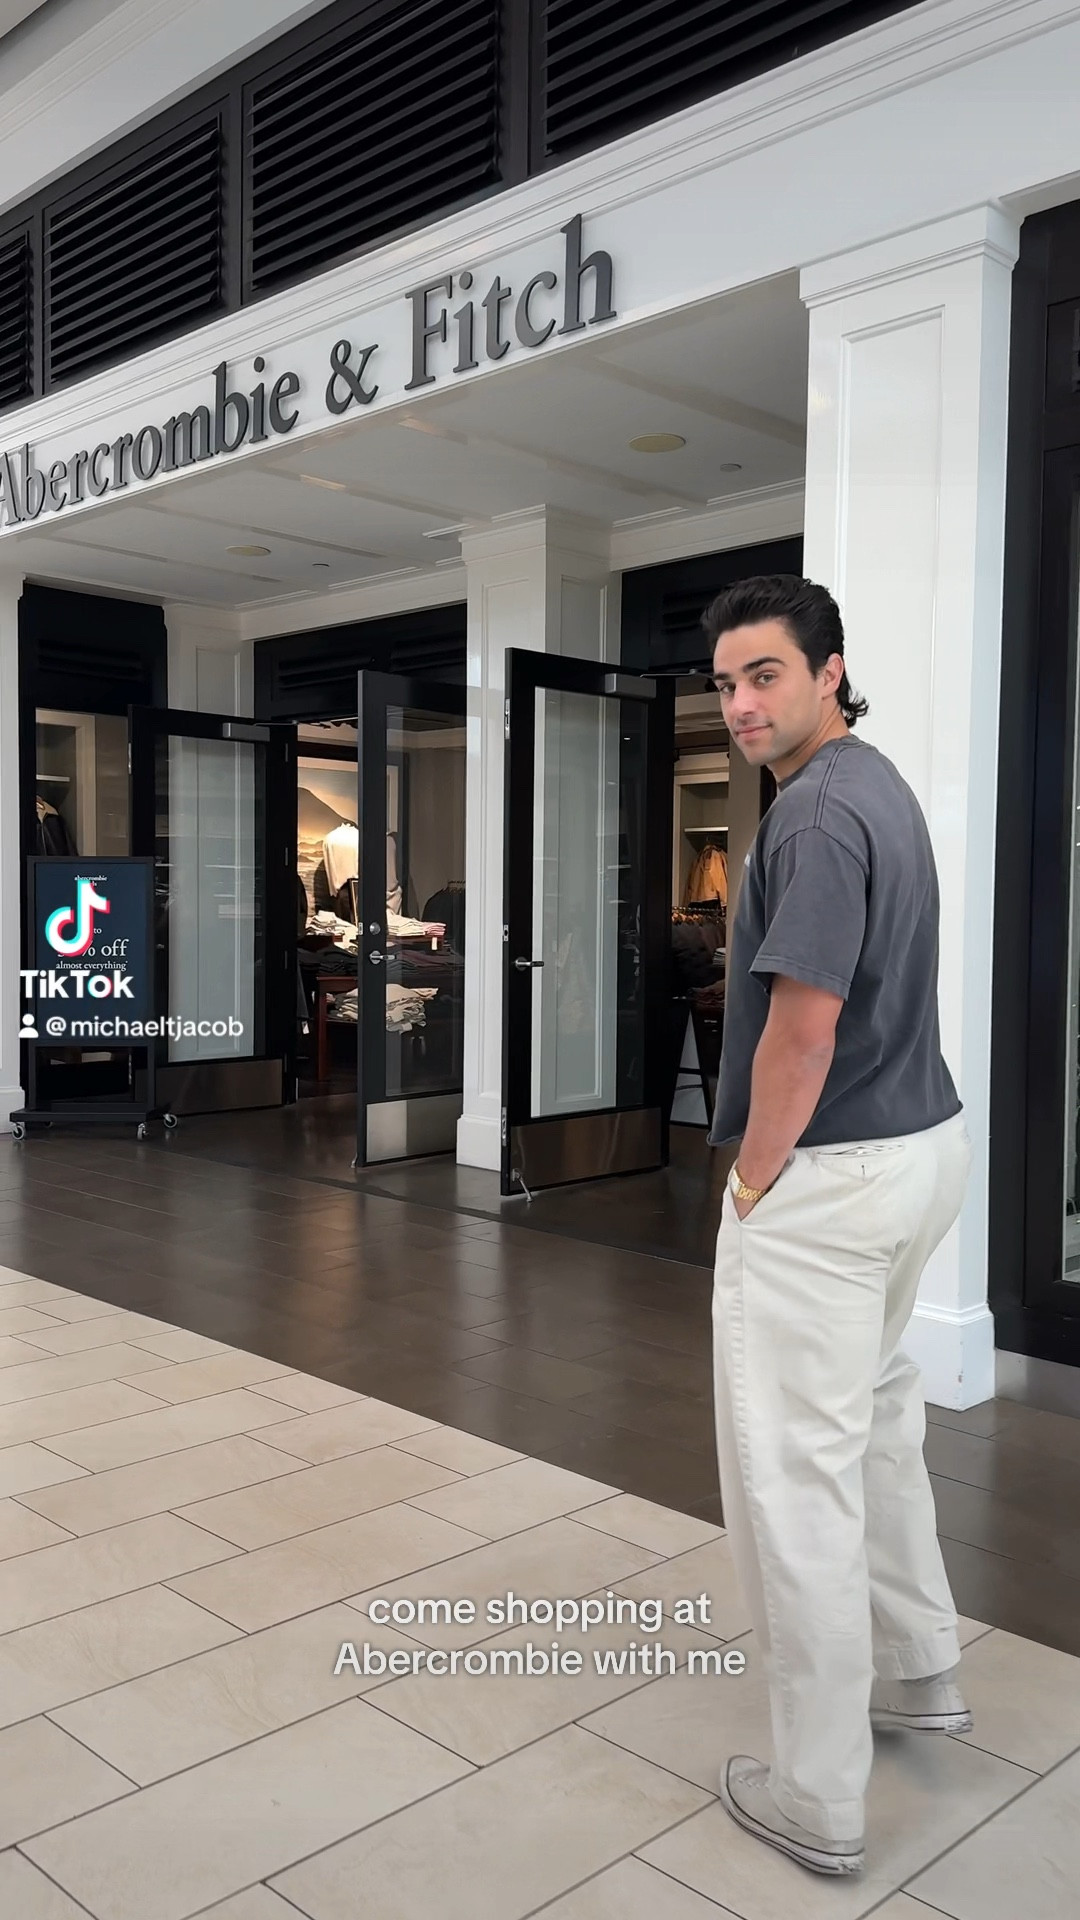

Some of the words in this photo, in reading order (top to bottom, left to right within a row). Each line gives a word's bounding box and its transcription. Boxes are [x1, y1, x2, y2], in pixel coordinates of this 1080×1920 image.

[0, 357, 301, 526] Abercrombie
[325, 339, 379, 415] &
[404, 213, 617, 391] Fitch
[101, 938, 130, 957] off
[55, 961, 82, 969] almost
